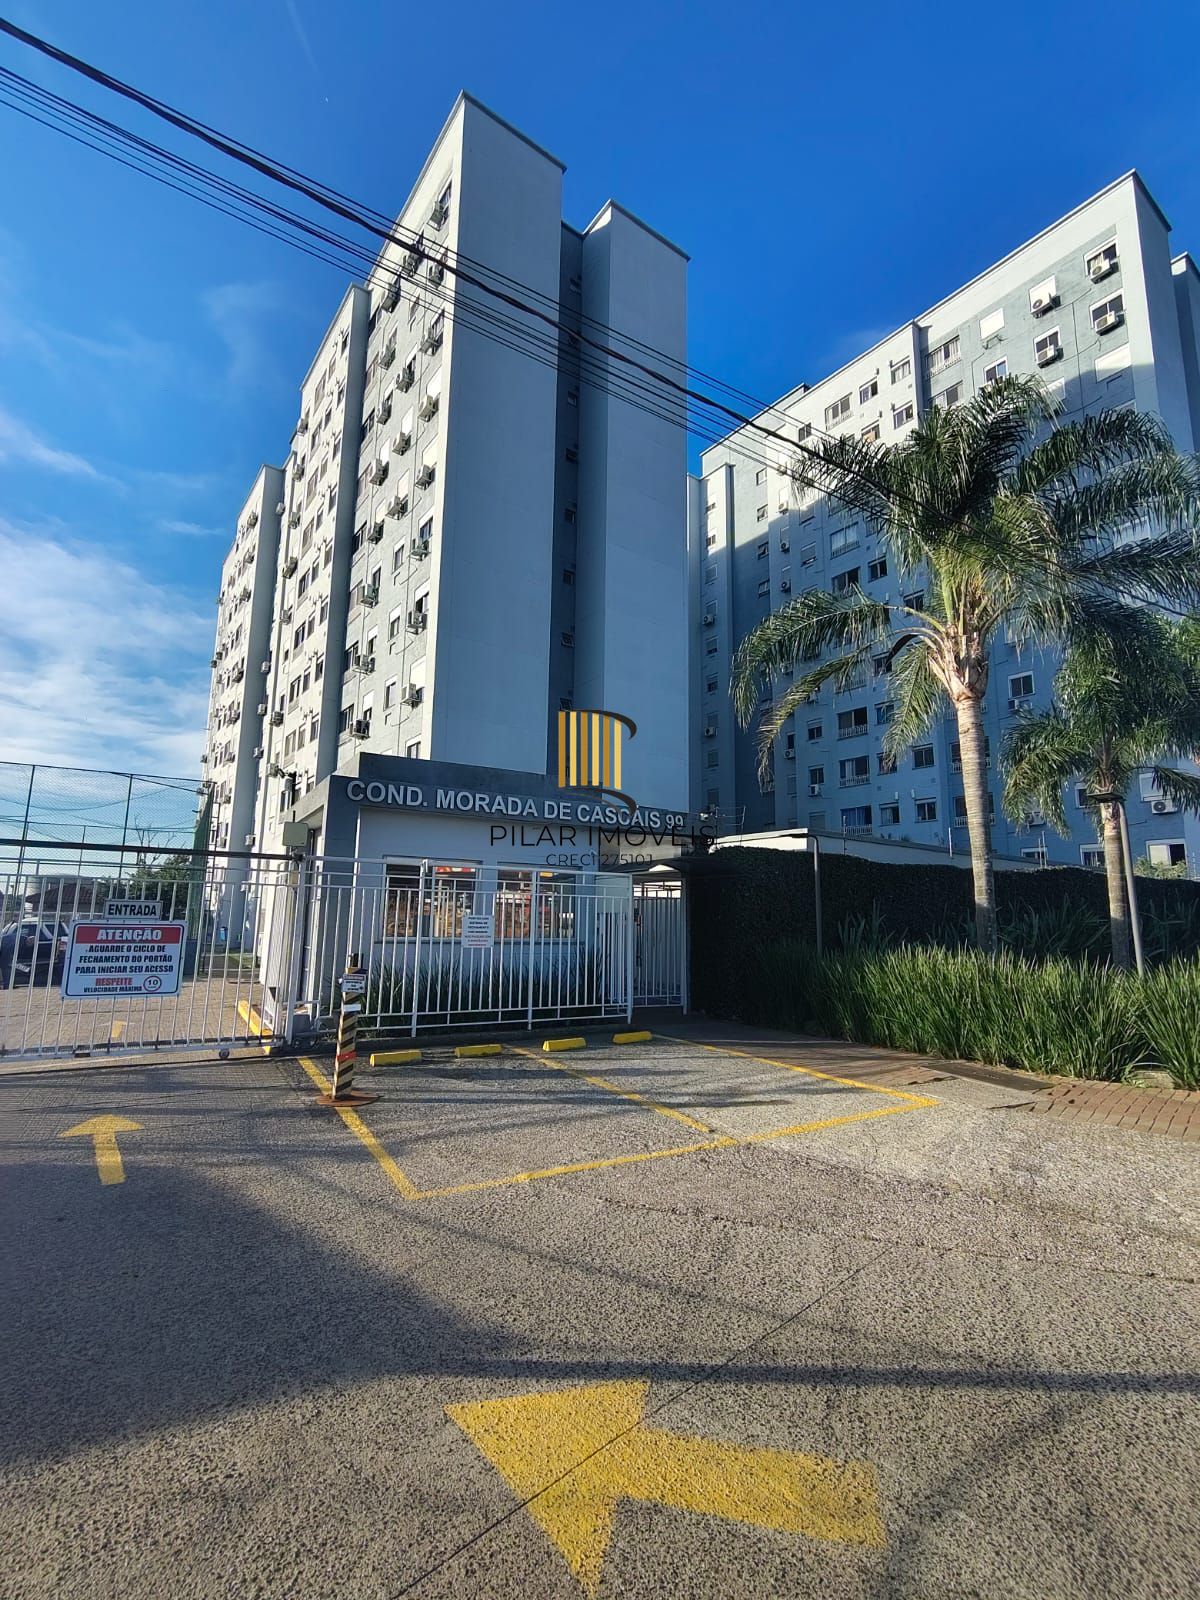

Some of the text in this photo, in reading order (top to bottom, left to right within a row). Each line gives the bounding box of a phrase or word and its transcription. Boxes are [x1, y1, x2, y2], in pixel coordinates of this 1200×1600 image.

[346, 780, 684, 830] COND. MORADA DE CASCAIS 99
[108, 904, 157, 916] ENTRADA
[96, 927, 162, 942] ATENÇÃO
[88, 945, 166, 953] AGUARDE O CICLO DE
[79, 955, 130, 963] FECHAMENTO
[143, 953, 173, 962] PORTÃO
[75, 966, 96, 974] PARA
[97, 966, 128, 974] INICIAR
[144, 965, 174, 973] ACESSO
[95, 977, 133, 986] RESPEITE
